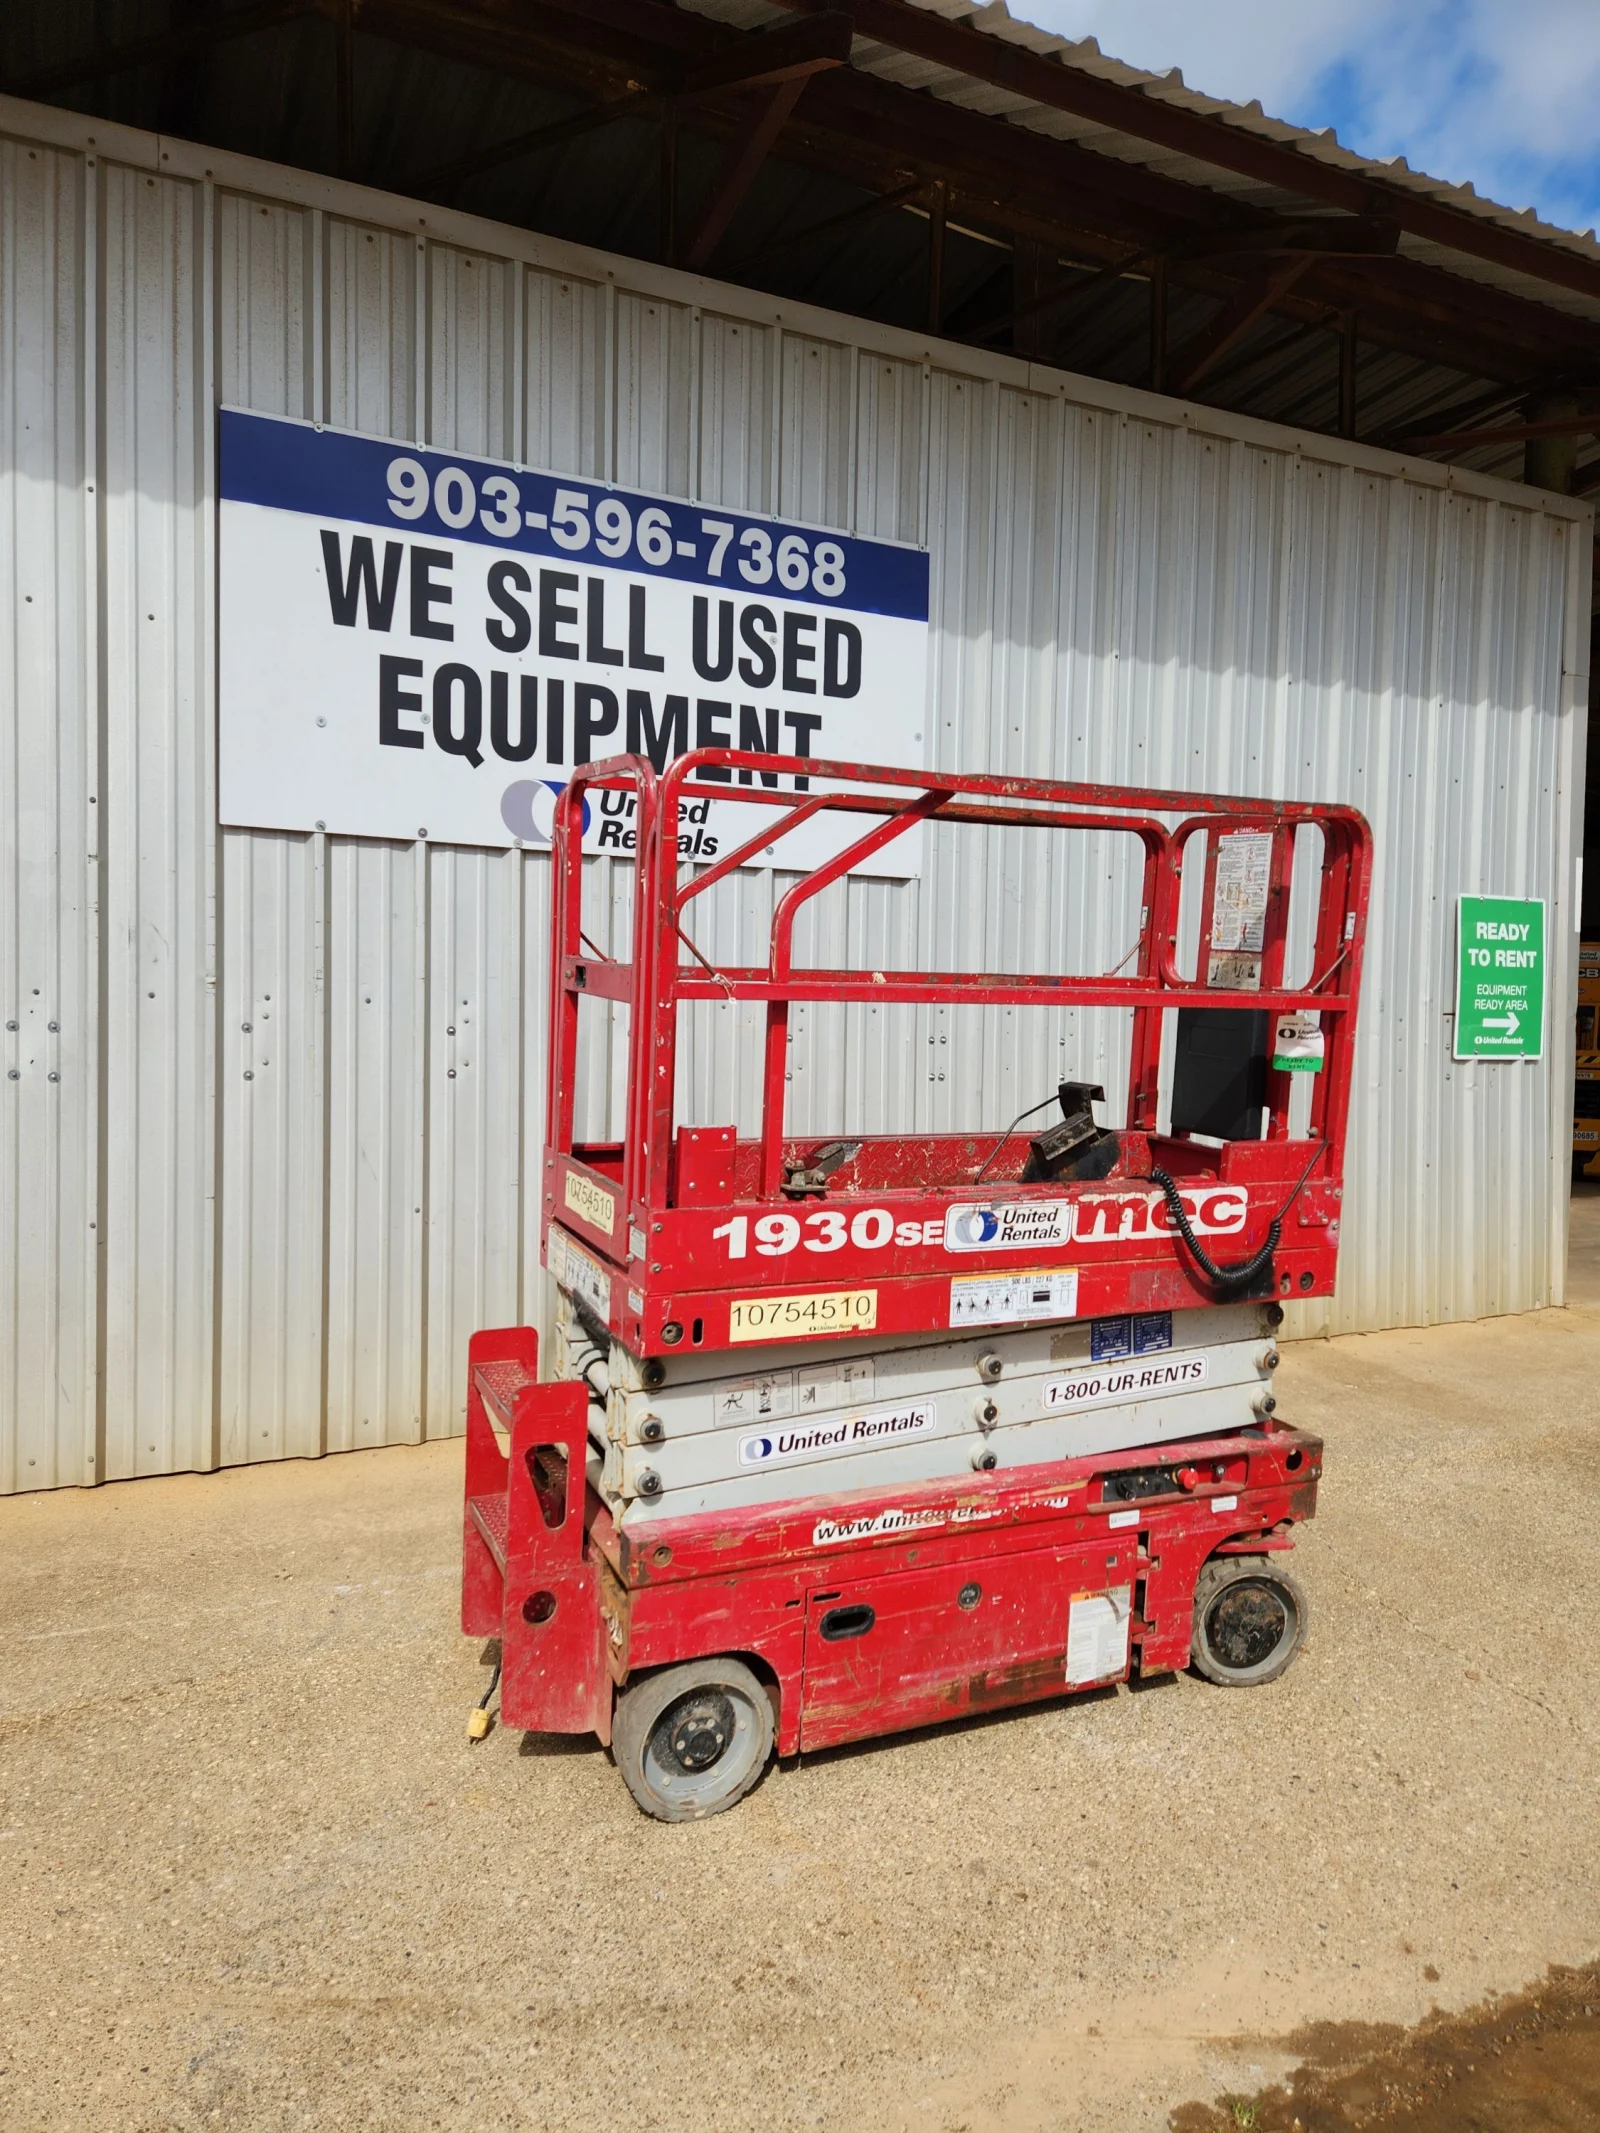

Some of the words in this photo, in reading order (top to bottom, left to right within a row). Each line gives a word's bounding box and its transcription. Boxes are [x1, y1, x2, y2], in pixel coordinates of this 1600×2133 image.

[386, 457, 847, 597] 903-596-7368
[320, 529, 454, 642] WE
[486, 560, 664, 673] SELL
[692, 595, 862, 699] USED
[380, 654, 822, 792] EQUIPMENT
[600, 788, 710, 824] Uned
[598, 820, 718, 855] Reals
[1476, 921, 1530, 941] READY
[1468, 948, 1491, 967] TO
[1495, 949, 1537, 968] RENT
[1474, 999, 1504, 1010] READY
[1505, 1000, 1528, 1011] AREA
[1476, 983, 1527, 996] EQUIPMENT
[1483, 1036, 1502, 1044] United
[1502, 1036, 1524, 1045] Rentals
[566, 1175, 613, 1221] 10754510
[1003, 1207, 1058, 1224] United
[1076, 1192, 1246, 1236] mec
[1001, 1223, 1061, 1241] Rentals
[731, 1295, 871, 1327] 10754510
[1049, 1362, 1202, 1402] 1-800-UR-RENTS
[778, 1424, 847, 1453] United
[852, 1411, 924, 1440] Rentals
